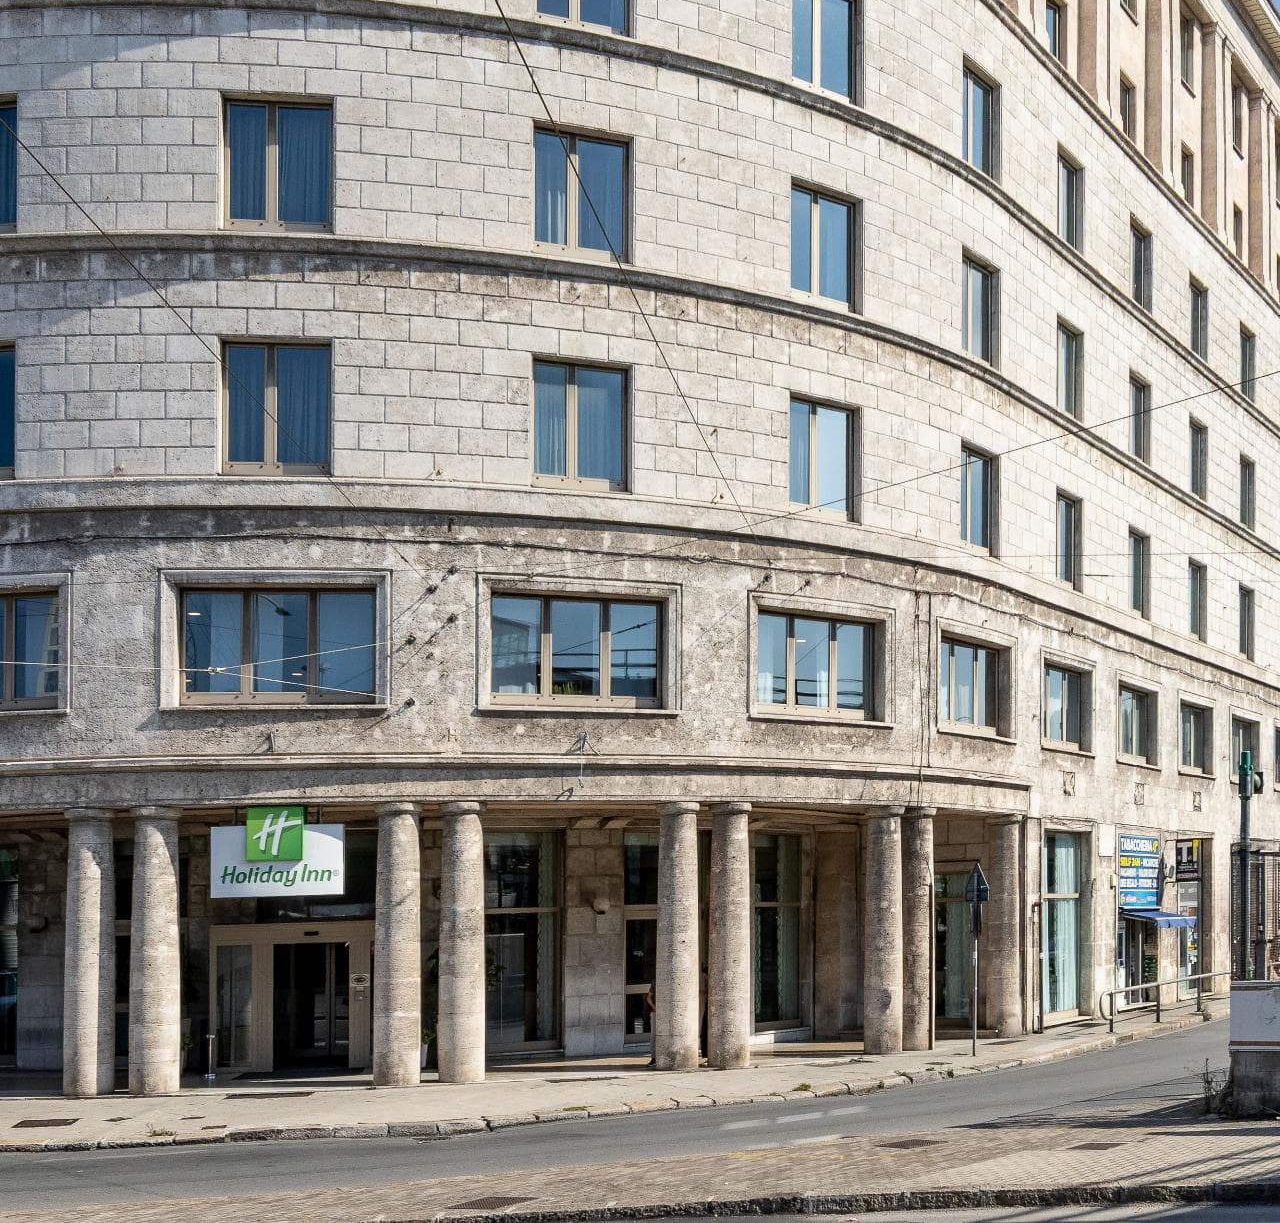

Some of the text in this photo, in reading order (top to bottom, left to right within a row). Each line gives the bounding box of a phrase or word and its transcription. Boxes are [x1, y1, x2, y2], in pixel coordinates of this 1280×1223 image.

[1120, 838, 1152, 852] TABACCHERIA
[220, 863, 332, 887] Holiday Inn
